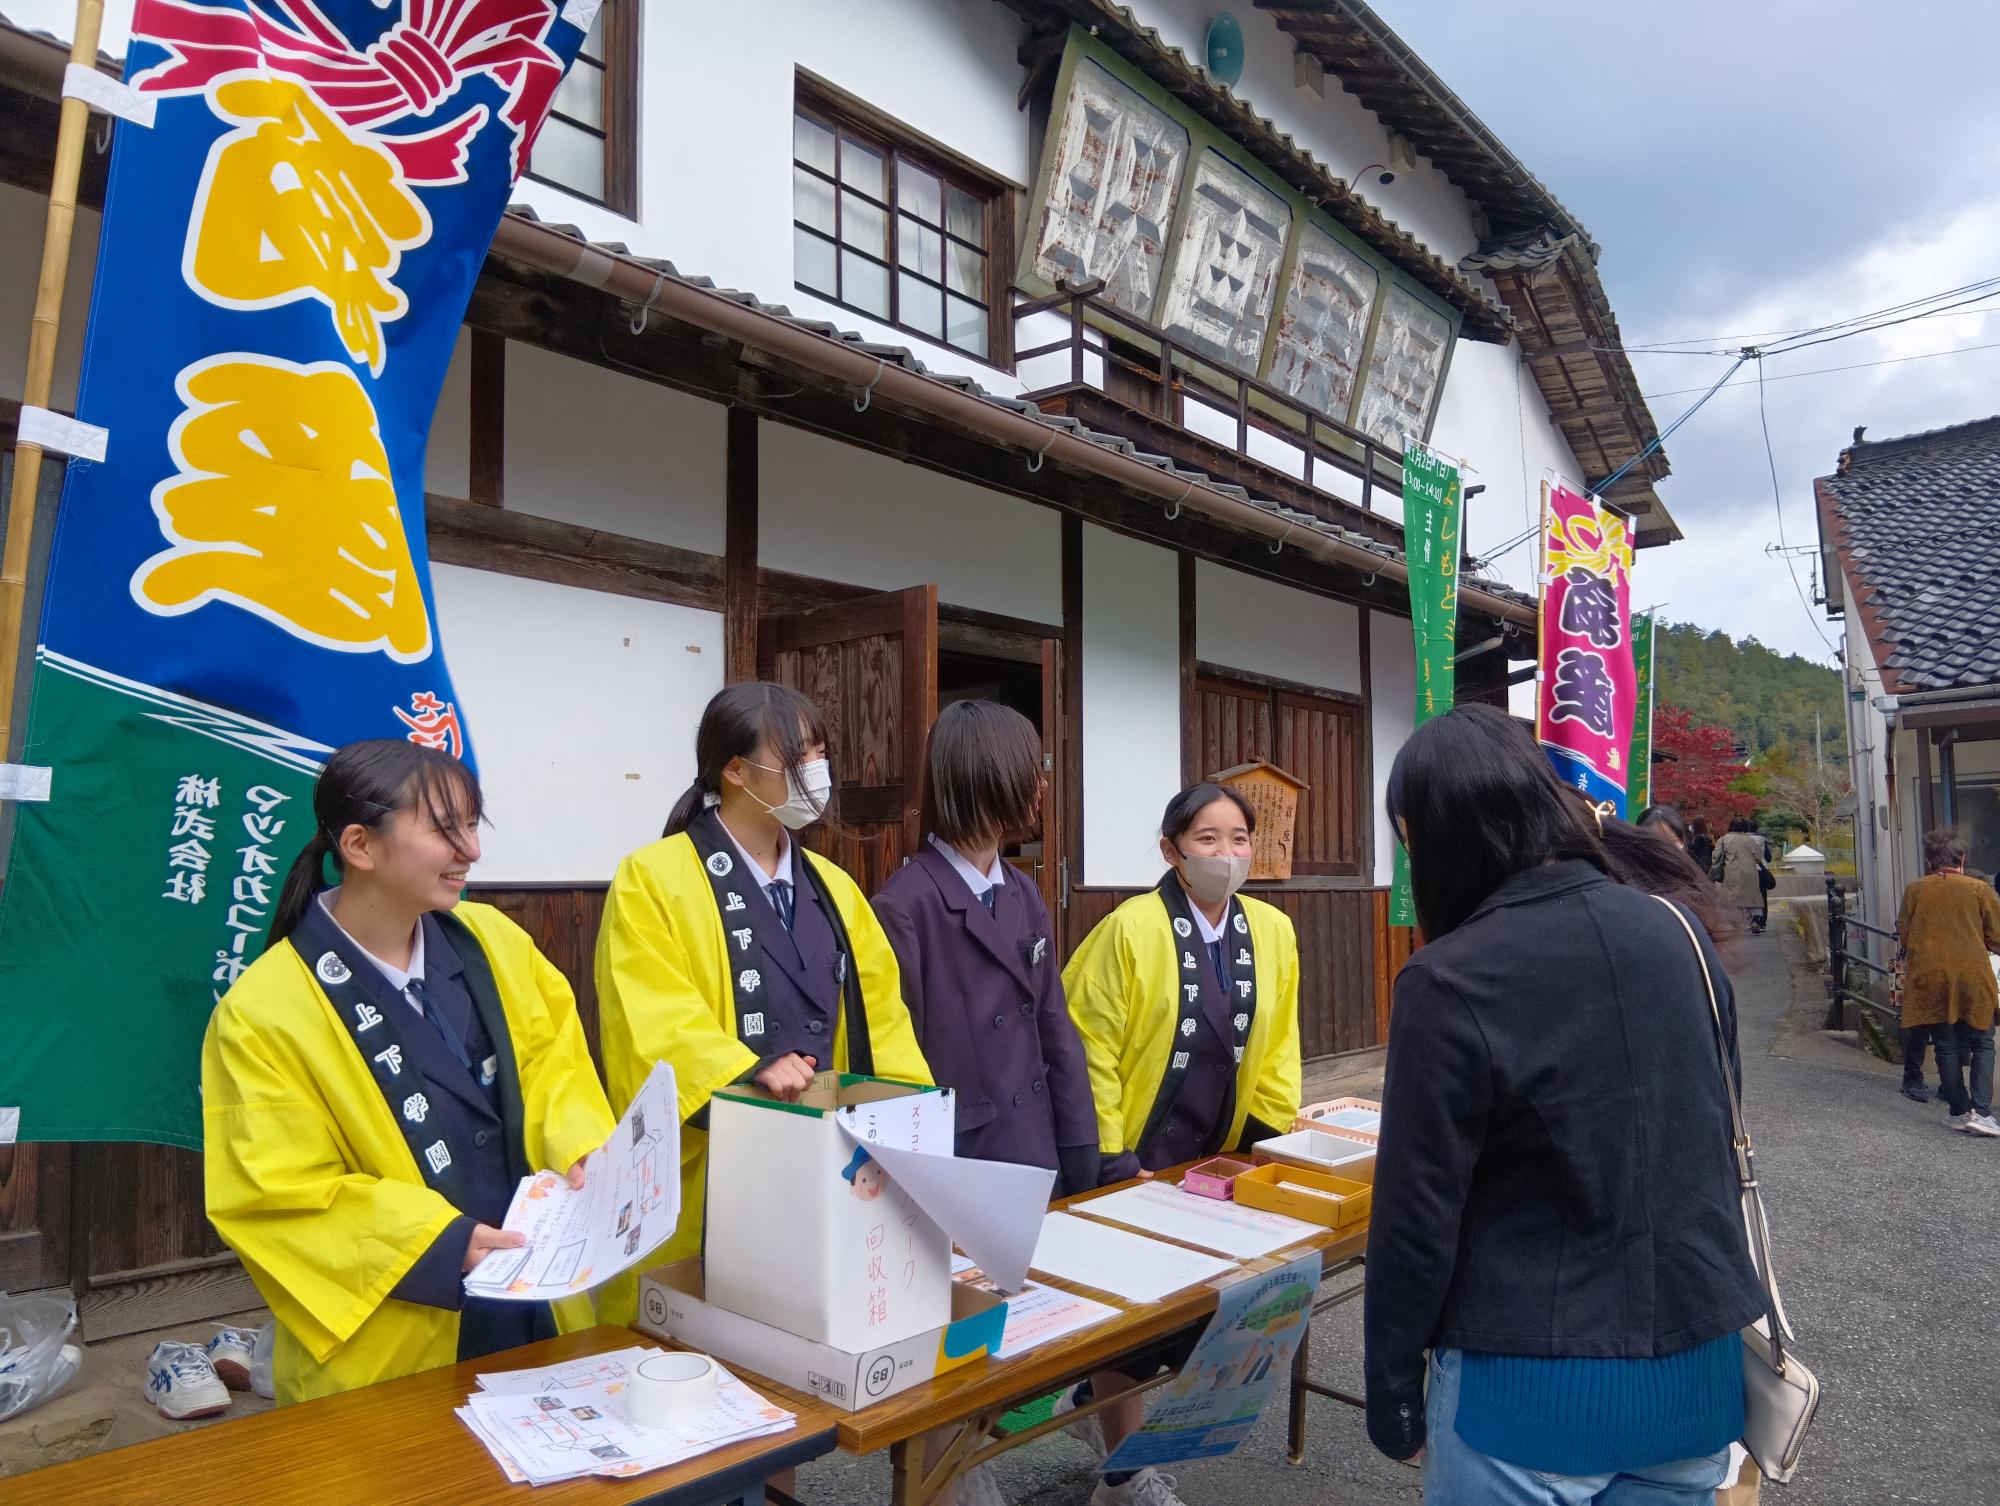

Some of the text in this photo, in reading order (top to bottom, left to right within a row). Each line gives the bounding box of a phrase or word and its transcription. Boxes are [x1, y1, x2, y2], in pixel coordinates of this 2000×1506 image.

[725, 891, 765, 1037] 上下学園
[1172, 951, 1199, 1069] 上下学園
[355, 1002, 452, 1175] 上下学園
[867, 1114, 877, 1144] この
[649, 1299, 662, 1315] B5
[866, 1223, 888, 1326] 回収箱
[872, 1367, 889, 1385] B5
